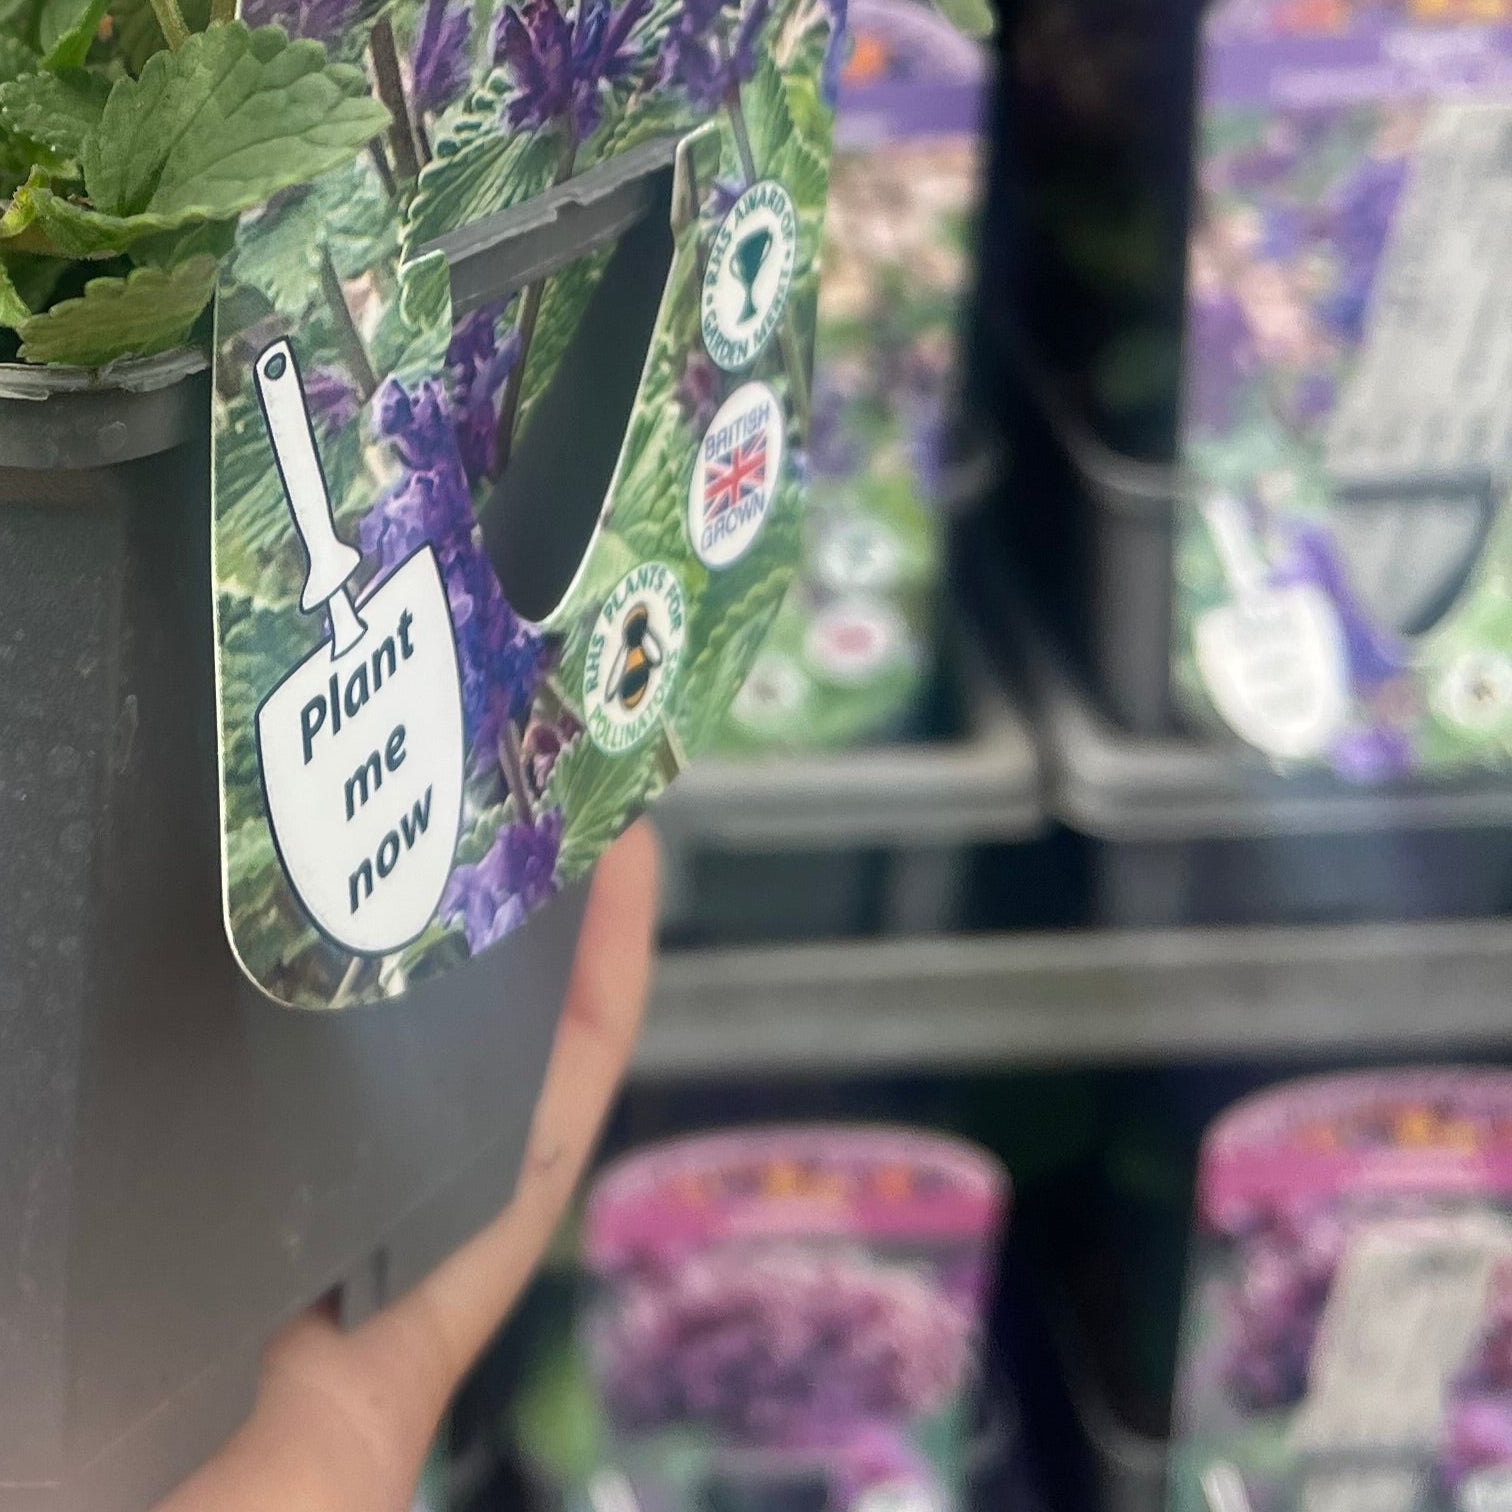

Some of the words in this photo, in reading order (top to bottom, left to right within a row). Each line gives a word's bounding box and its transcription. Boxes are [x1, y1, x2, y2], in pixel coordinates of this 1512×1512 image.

[705, 229, 732, 287] RHS
[734, 185, 786, 229] AWARD
[781, 209, 794, 240] OF
[703, 309, 750, 361] GARDEN
[704, 399, 771, 461] BRITISH
[701, 493, 765, 553] GROWN
[586, 633, 605, 694] RHS
[602, 564, 667, 623] PLANTS
[665, 584, 683, 634] FOR
[300, 607, 414, 766] Plant
[344, 723, 407, 822] me
[348, 784, 433, 915] now
